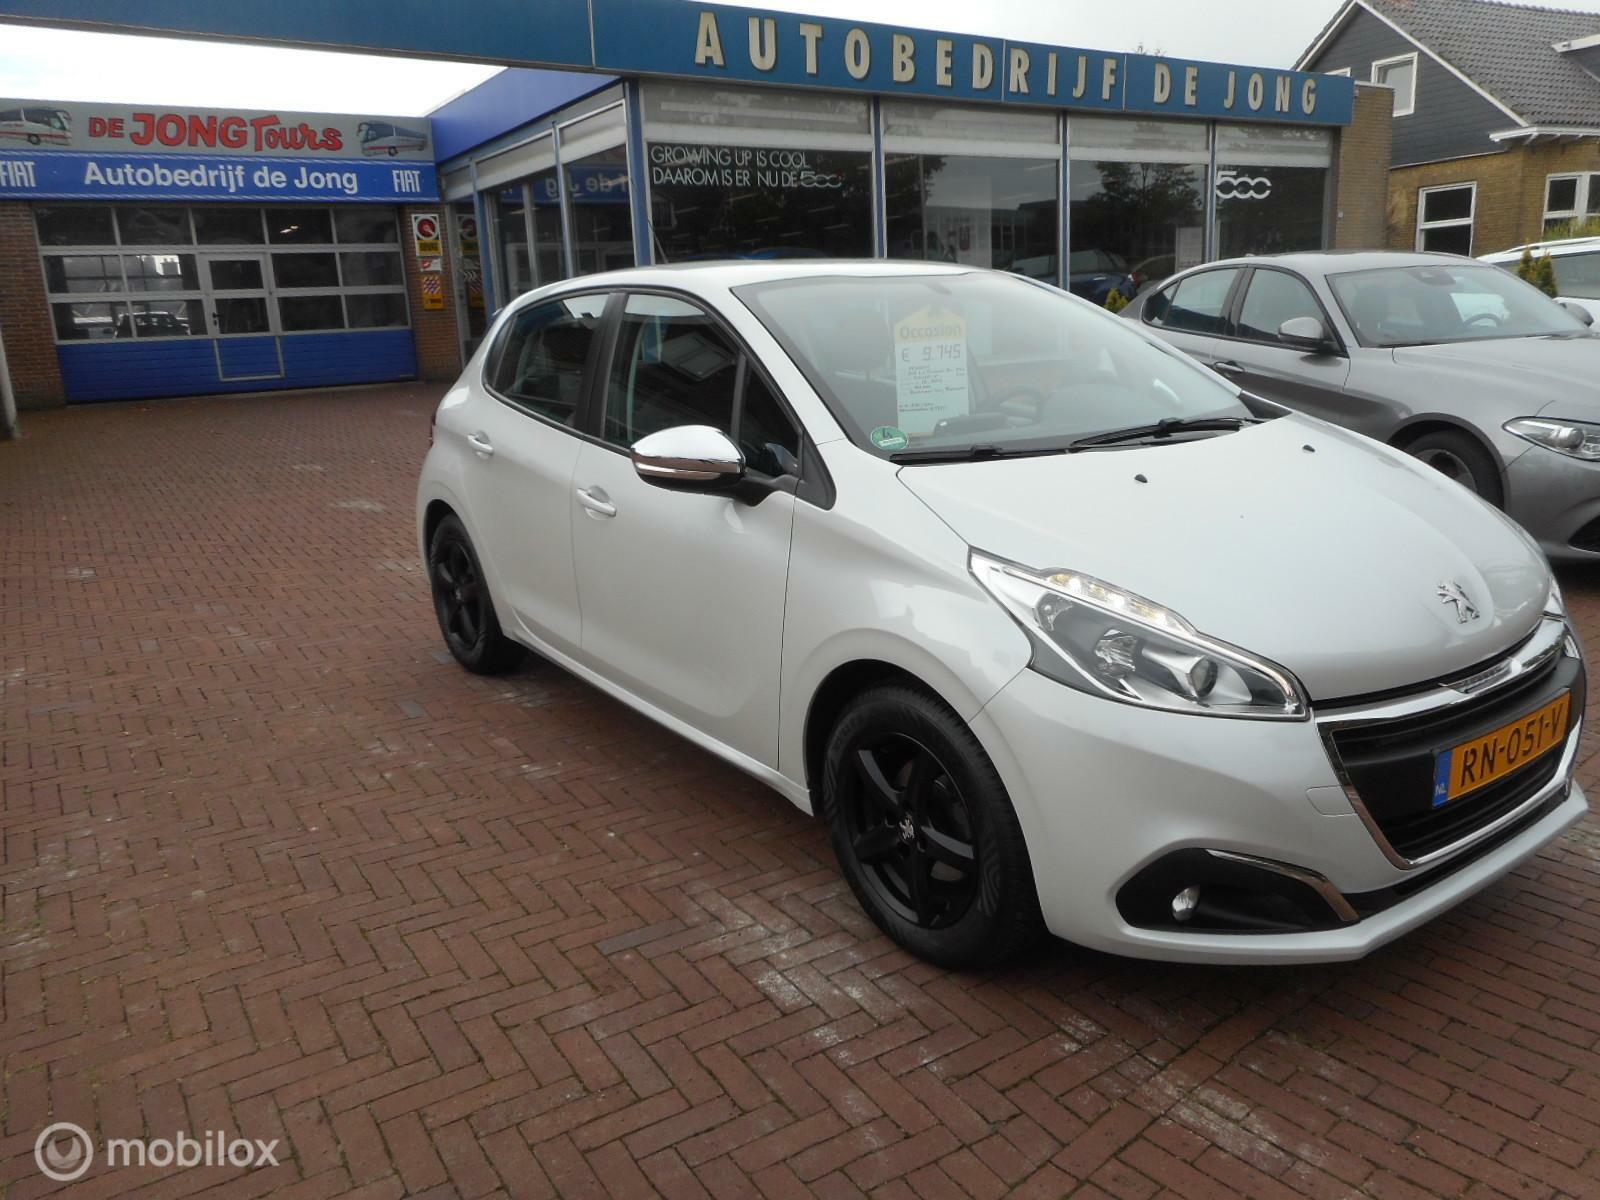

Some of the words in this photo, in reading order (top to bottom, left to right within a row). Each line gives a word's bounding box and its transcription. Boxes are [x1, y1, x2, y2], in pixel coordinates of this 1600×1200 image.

[694, 11, 1118, 101] AUTOBEDRIJF
[1153, 62, 1198, 106] DE
[1223, 71, 1317, 115] JONG
[88, 116, 125, 138] DE
[650, 145, 731, 166] GROWING
[735, 149, 752, 167] UP
[756, 150, 767, 167] IS
[769, 150, 811, 168] COOL
[0, 160, 37, 188] FIAT
[84, 162, 246, 194] Autobedrijf
[253, 165, 287, 188] de
[294, 167, 358, 194] Jong
[391, 169, 421, 193] FIAT
[652, 167, 719, 185] DAAROM
[721, 169, 733, 186] IS
[735, 169, 751, 187] ER
[757, 170, 778, 187] NU
[781, 171, 798, 188] DE
[799, 170, 843, 188] 500
[1215, 170, 1272, 199] 500
[899, 324, 961, 340] Occasion
[1460, 702, 1564, 788] RN-051-V
